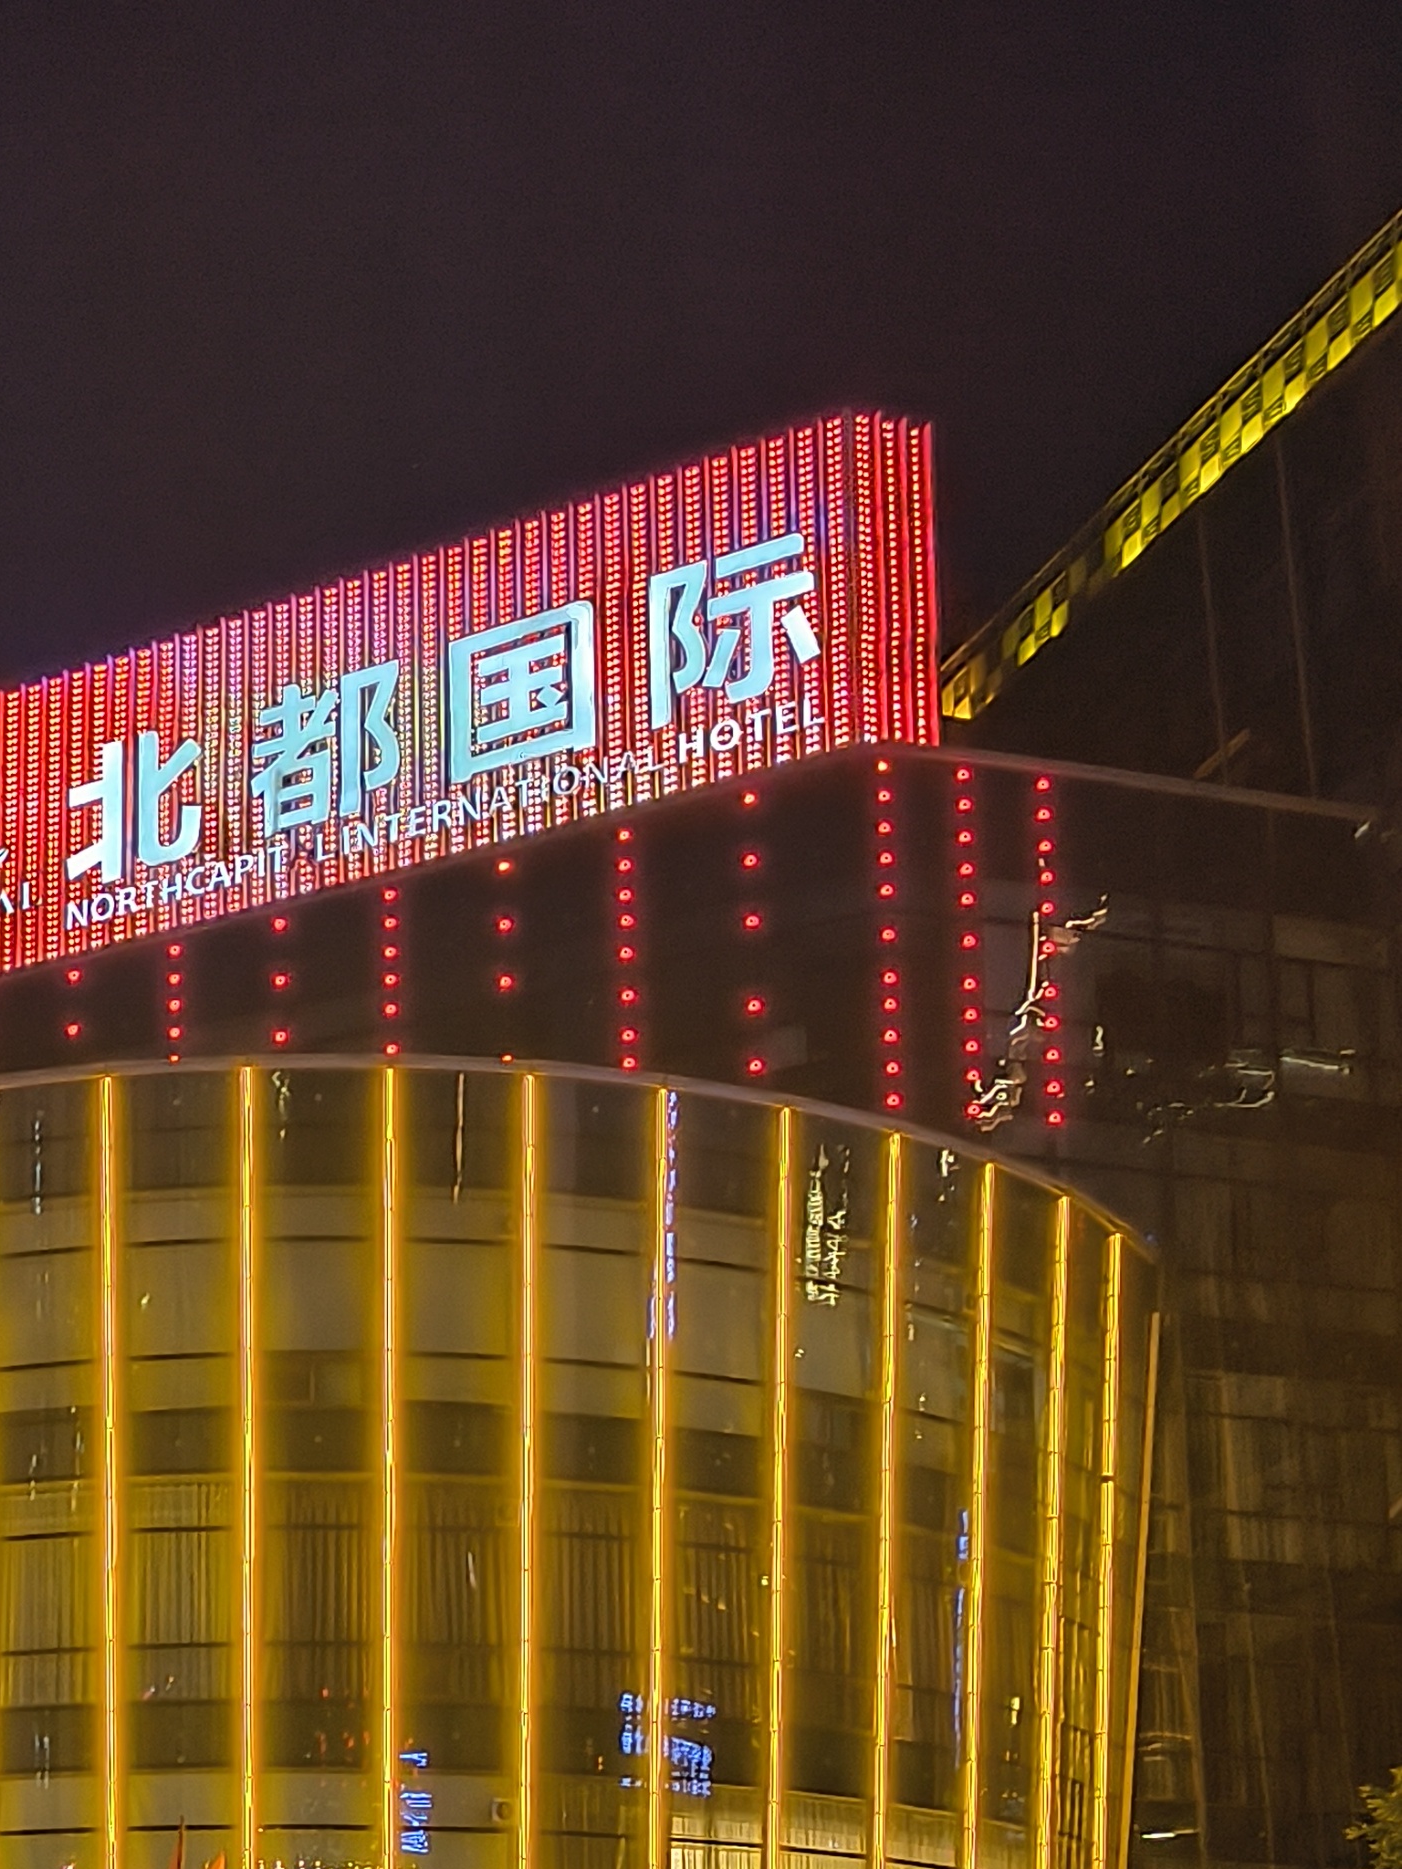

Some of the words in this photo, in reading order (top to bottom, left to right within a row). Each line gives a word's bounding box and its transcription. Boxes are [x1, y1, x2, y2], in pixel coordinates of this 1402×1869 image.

[64, 833, 336, 930] NORTHCAPITL
[341, 745, 666, 856] INTERNATIONAL
[678, 696, 826, 764] HOTEL
[66, 532, 822, 882] 北都国际
